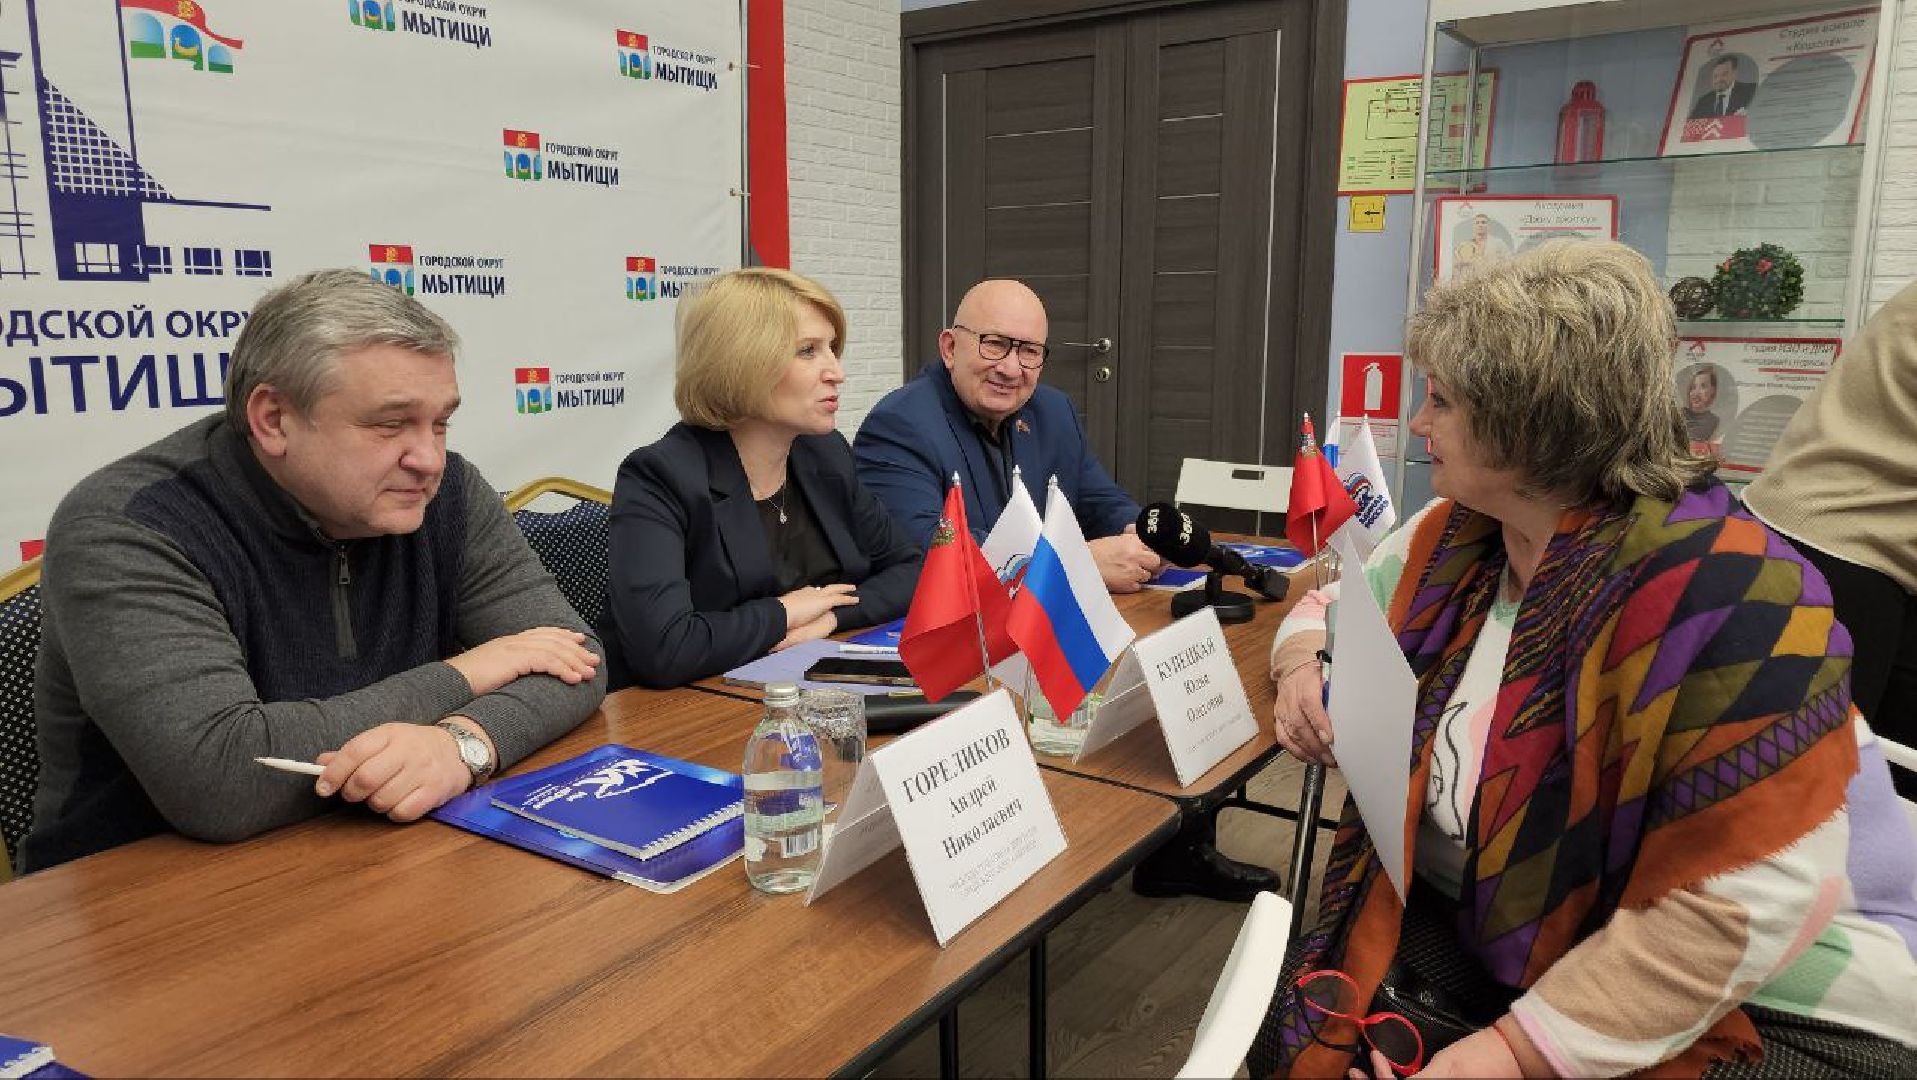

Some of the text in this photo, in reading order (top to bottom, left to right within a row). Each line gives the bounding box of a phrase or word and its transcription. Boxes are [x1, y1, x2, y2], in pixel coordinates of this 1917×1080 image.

[399, 0, 486, 19] ОДСКОЙ ОКРУГ
[402, 10, 491, 49] МЫТИЩИ
[652, 46, 694, 61] ГОРОДСКОЙ
[655, 62, 718, 91] МЫТИЩИ
[546, 143, 618, 160] ГОРОДСКОЙ ОКРУГ
[548, 160, 619, 188] МЫТИЩИ
[420, 256, 504, 269] ГОРОДСКОЙ ОКРУГ
[422, 274, 505, 298] МЫТИЩИ
[0, 304, 154, 347] ДСКОЙ
[555, 371, 600, 384] ГОРОДСКОЙ
[557, 387, 624, 408] МЫТИЩИ
[1156, 637, 1215, 681] КУПЕЦКАЯ
[902, 728, 1010, 803] ГОРЕЛИКОВ
[950, 774, 998, 818] Андрей
[942, 798, 1023, 858] Николаевич
